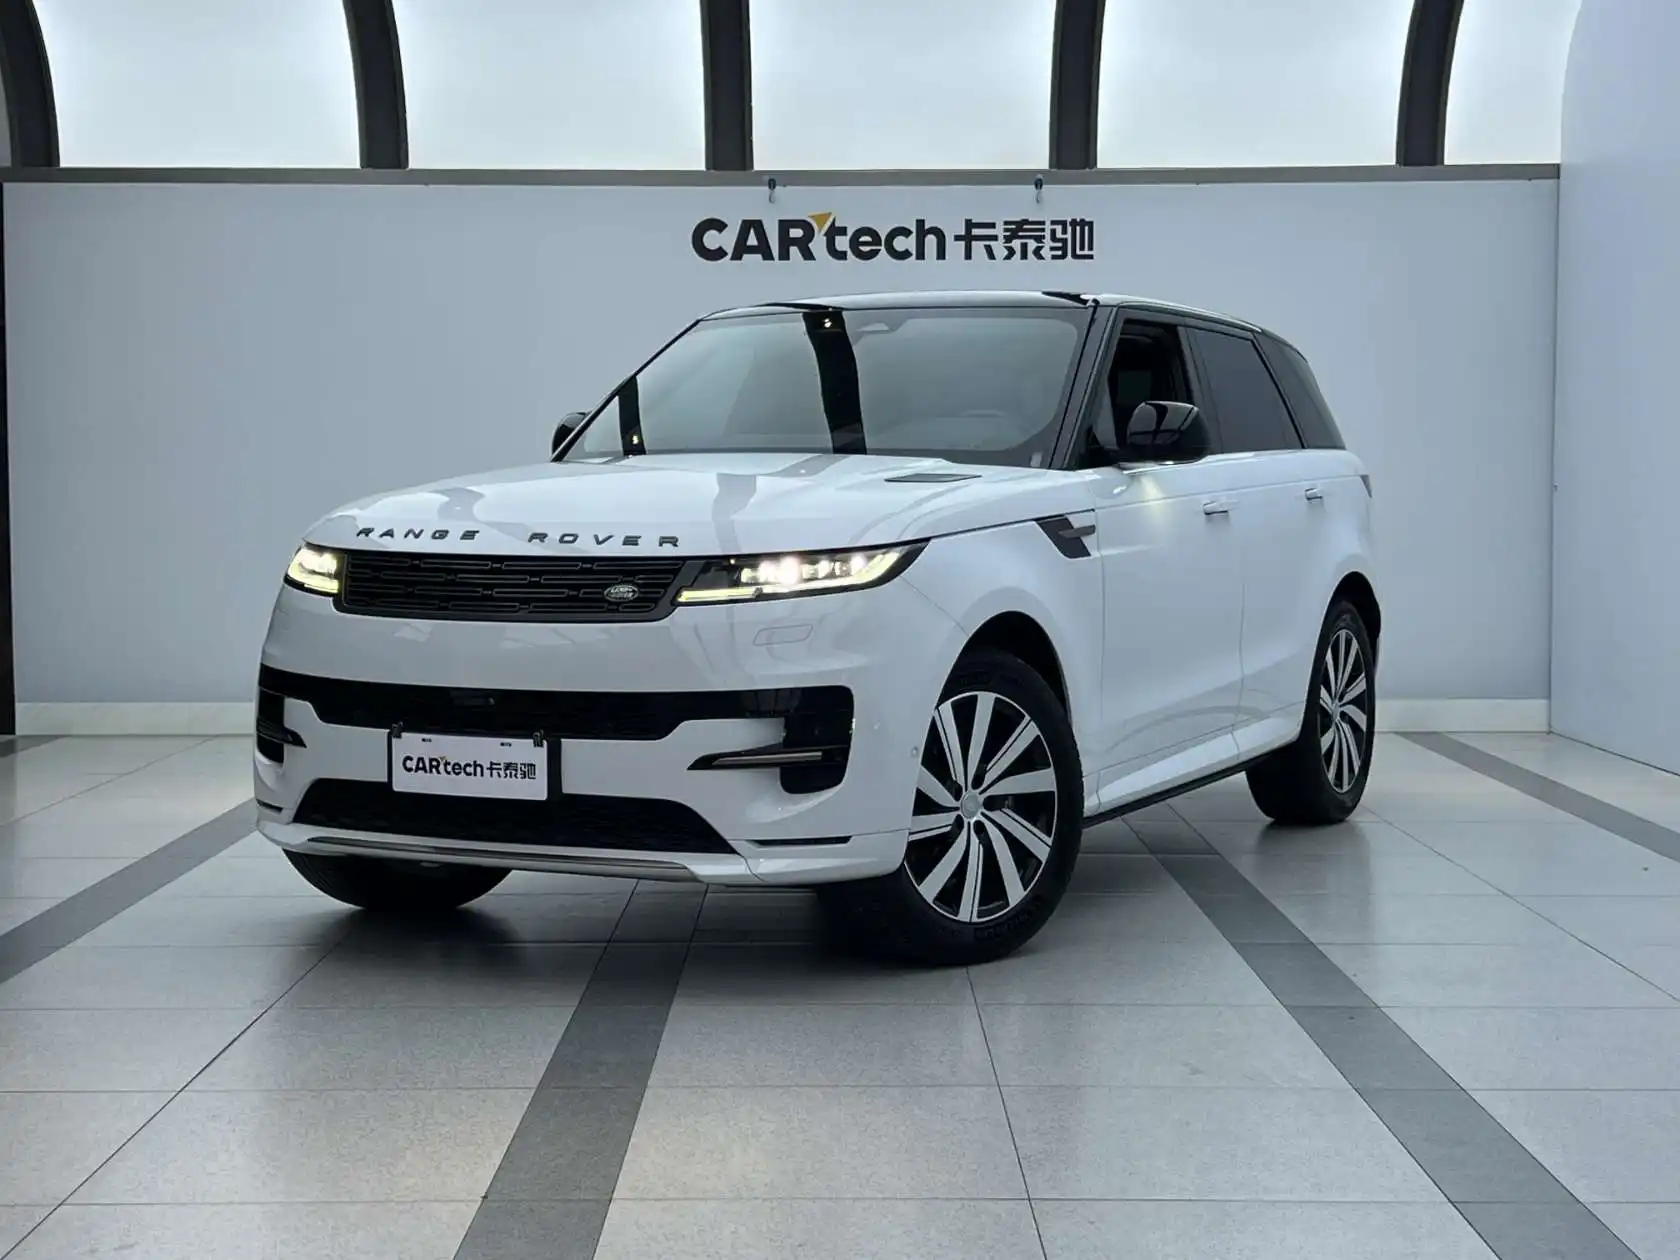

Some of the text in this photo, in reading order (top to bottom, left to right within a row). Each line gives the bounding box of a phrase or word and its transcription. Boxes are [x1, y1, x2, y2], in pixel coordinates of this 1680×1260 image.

[692, 214, 1094, 261] CARtech 卡泰驰
[356, 527, 680, 548] RANGE ROVER
[402, 755, 536, 780] CARtech 卡泰驰
